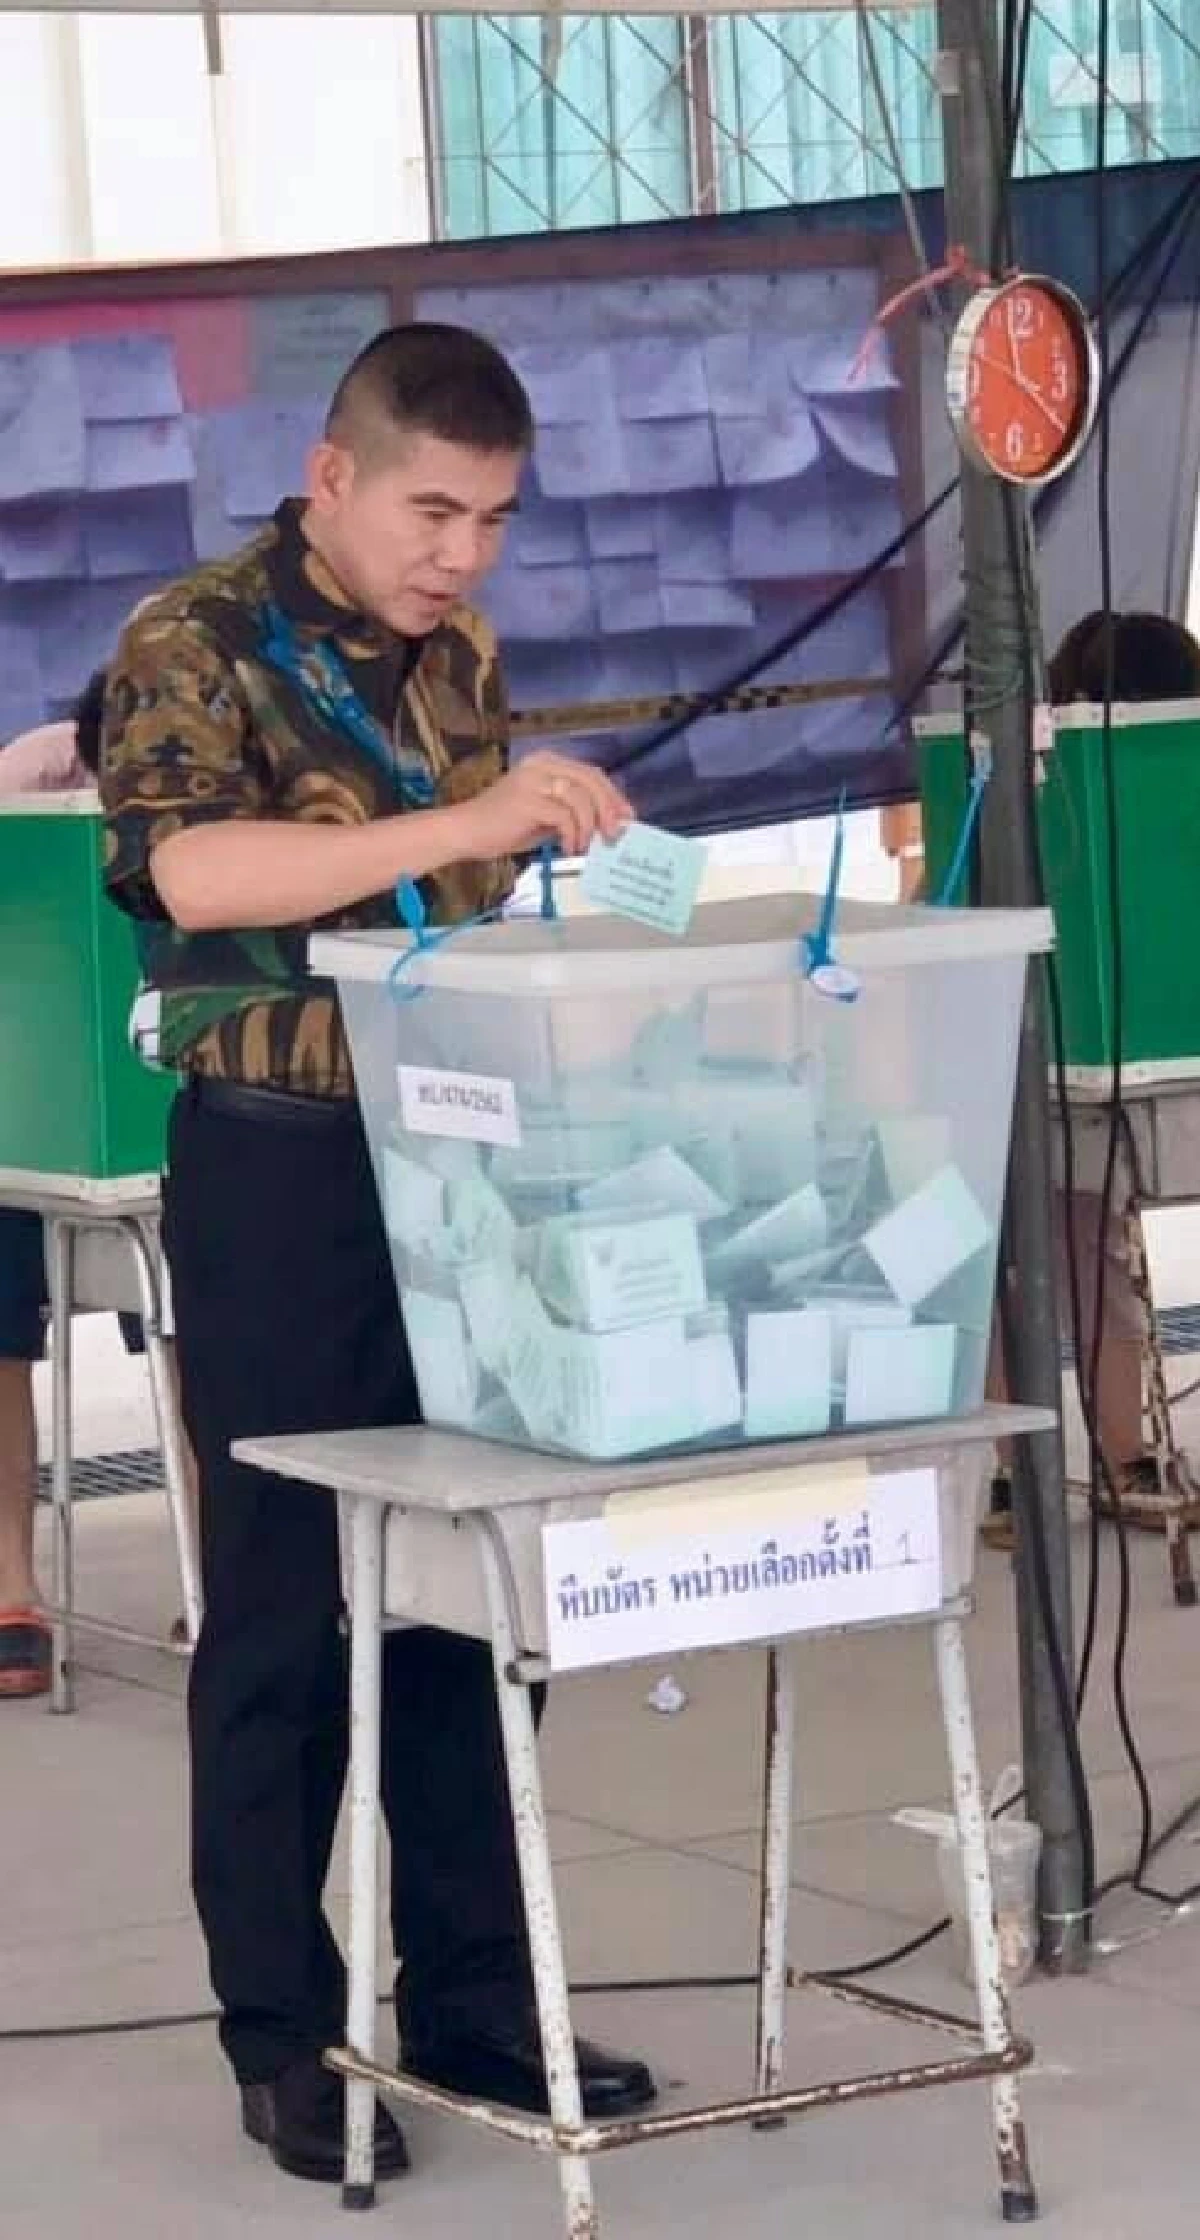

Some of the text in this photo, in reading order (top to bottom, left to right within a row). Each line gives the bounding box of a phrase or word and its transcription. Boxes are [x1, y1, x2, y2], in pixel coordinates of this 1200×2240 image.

[1051, 359, 1068, 401] 3
[1005, 421, 1024, 462] 6
[558, 1563, 657, 1620] หีบบัตร
[669, 1510, 873, 1602] หน่วยเลือกตั้งที่
